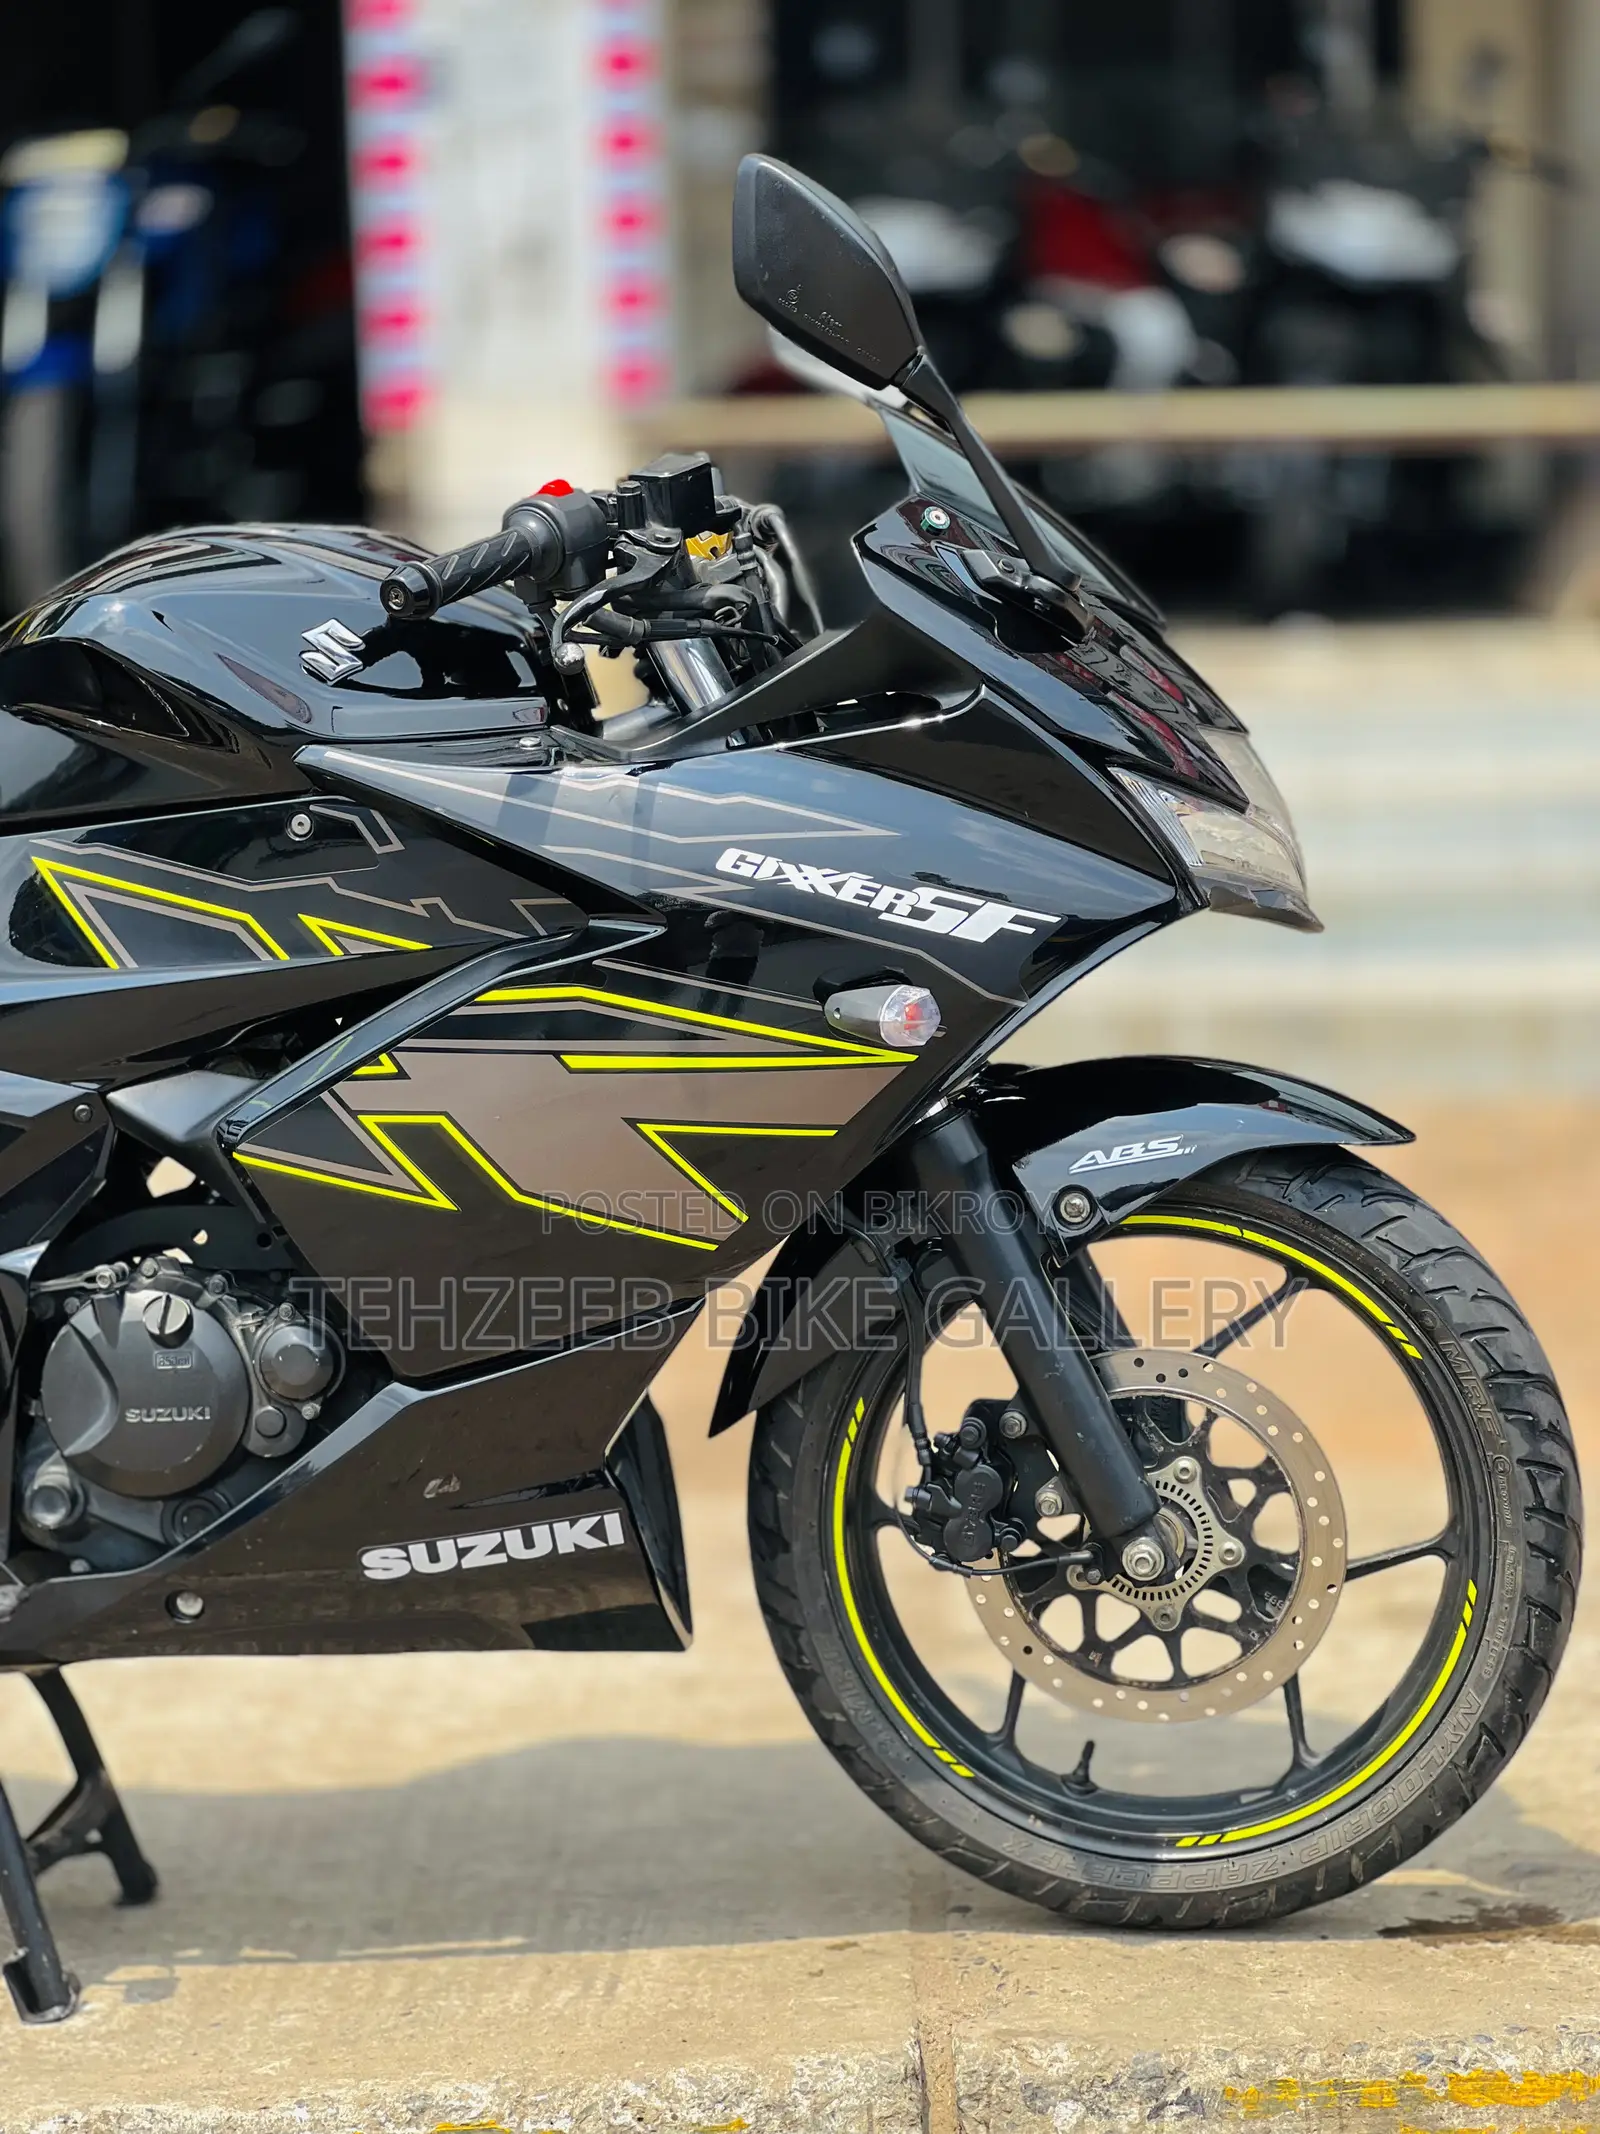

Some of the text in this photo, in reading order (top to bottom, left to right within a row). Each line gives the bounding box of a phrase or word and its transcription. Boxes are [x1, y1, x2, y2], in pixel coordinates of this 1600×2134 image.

[1069, 1134, 1184, 1174] ABS
[125, 1406, 211, 1423] SUZUKI
[1438, 1340, 1501, 1438] MRF
[361, 1512, 625, 1580] SUZUKI
[1300, 1688, 1482, 1864] NYLOGRIP
